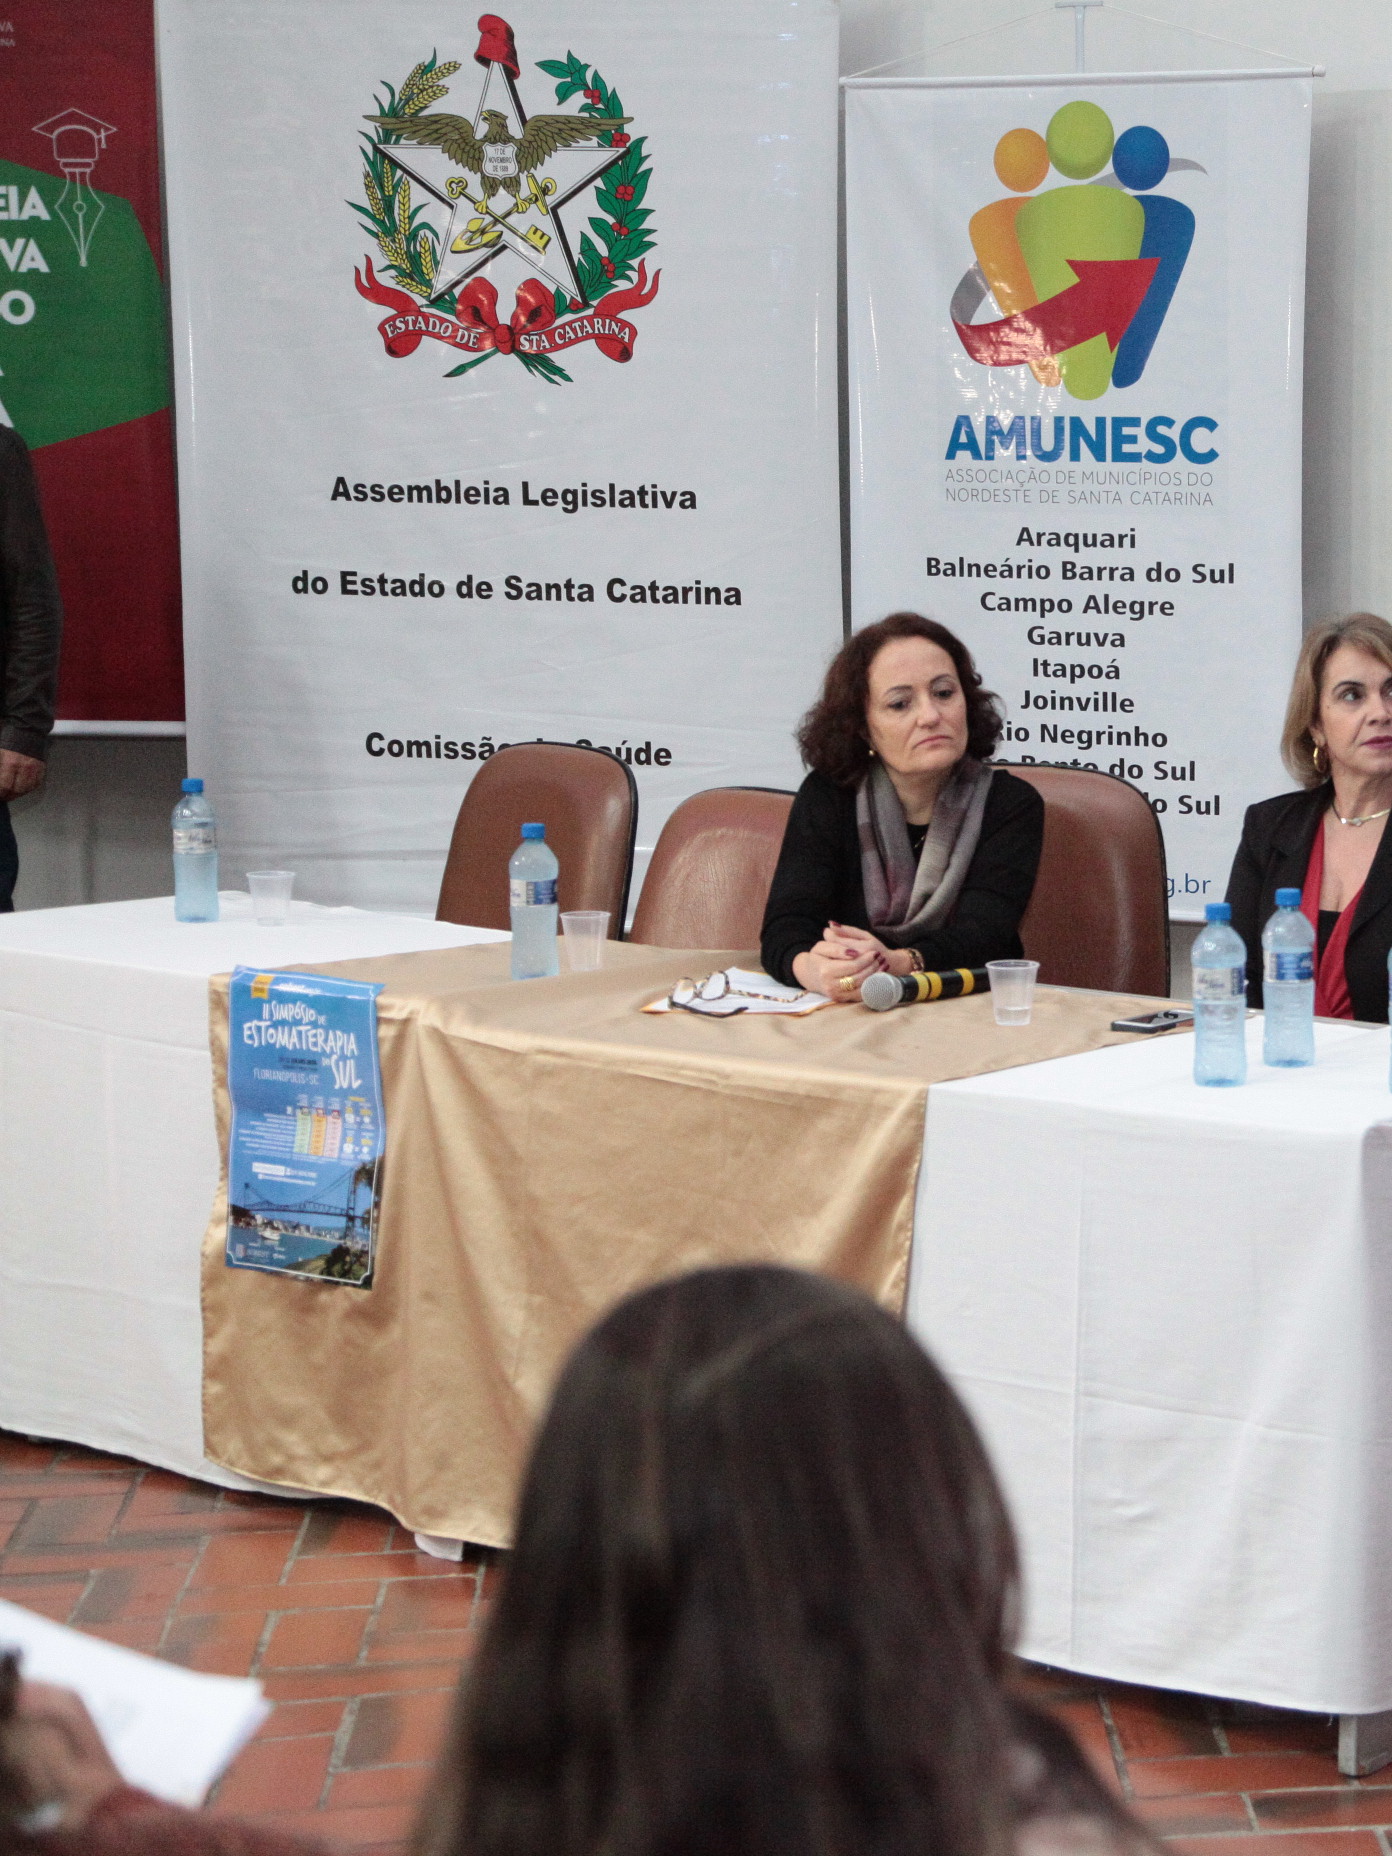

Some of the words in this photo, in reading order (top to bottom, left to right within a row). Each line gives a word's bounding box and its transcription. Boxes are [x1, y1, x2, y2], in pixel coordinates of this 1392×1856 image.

[385, 316, 452, 338] ESTADO
[456, 329, 480, 349] DE
[519, 334, 555, 351] STA.
[554, 319, 631, 344] CATARINA
[944, 414, 1220, 465] AMUNESC
[945, 467, 1051, 488] ASSOCIAÇÃO
[1055, 470, 1077, 485] DE
[1081, 468, 1182, 487] MUNICÍPIOS
[1187, 472, 1214, 487] DO
[330, 476, 510, 506] Assembleia
[521, 481, 698, 514] Legislativa
[945, 487, 1032, 504] NORDESTE
[1039, 489, 1060, 504] DE
[1067, 490, 1123, 505] SANTA
[1130, 490, 1214, 506] CATARINA
[1015, 526, 1137, 553] Araquari
[926, 556, 1051, 581] Balneário
[1061, 560, 1136, 582] Barra
[1145, 561, 1181, 583] do
[1191, 562, 1235, 584] Sul
[291, 570, 330, 595] do
[340, 570, 446, 599] Estado
[456, 574, 494, 600] de
[504, 575, 595, 602] Santa
[606, 577, 743, 606] Catarina
[979, 591, 1073, 618] Campo
[1082, 593, 1176, 621] Alegre
[1026, 625, 1126, 648] Garuva
[1032, 657, 1121, 684] Itapoá
[1020, 690, 1135, 713] Joinville
[1040, 723, 1168, 750] Negrinho
[575, 738, 673, 767] úde
[1109, 757, 1144, 780] do
[1154, 761, 1196, 782] Sul
[1143, 792, 1168, 814] o
[1178, 795, 1221, 816] Sul
[243, 1020, 358, 1057] ESTOMATERAPIA
[331, 1054, 362, 1089] SUL
